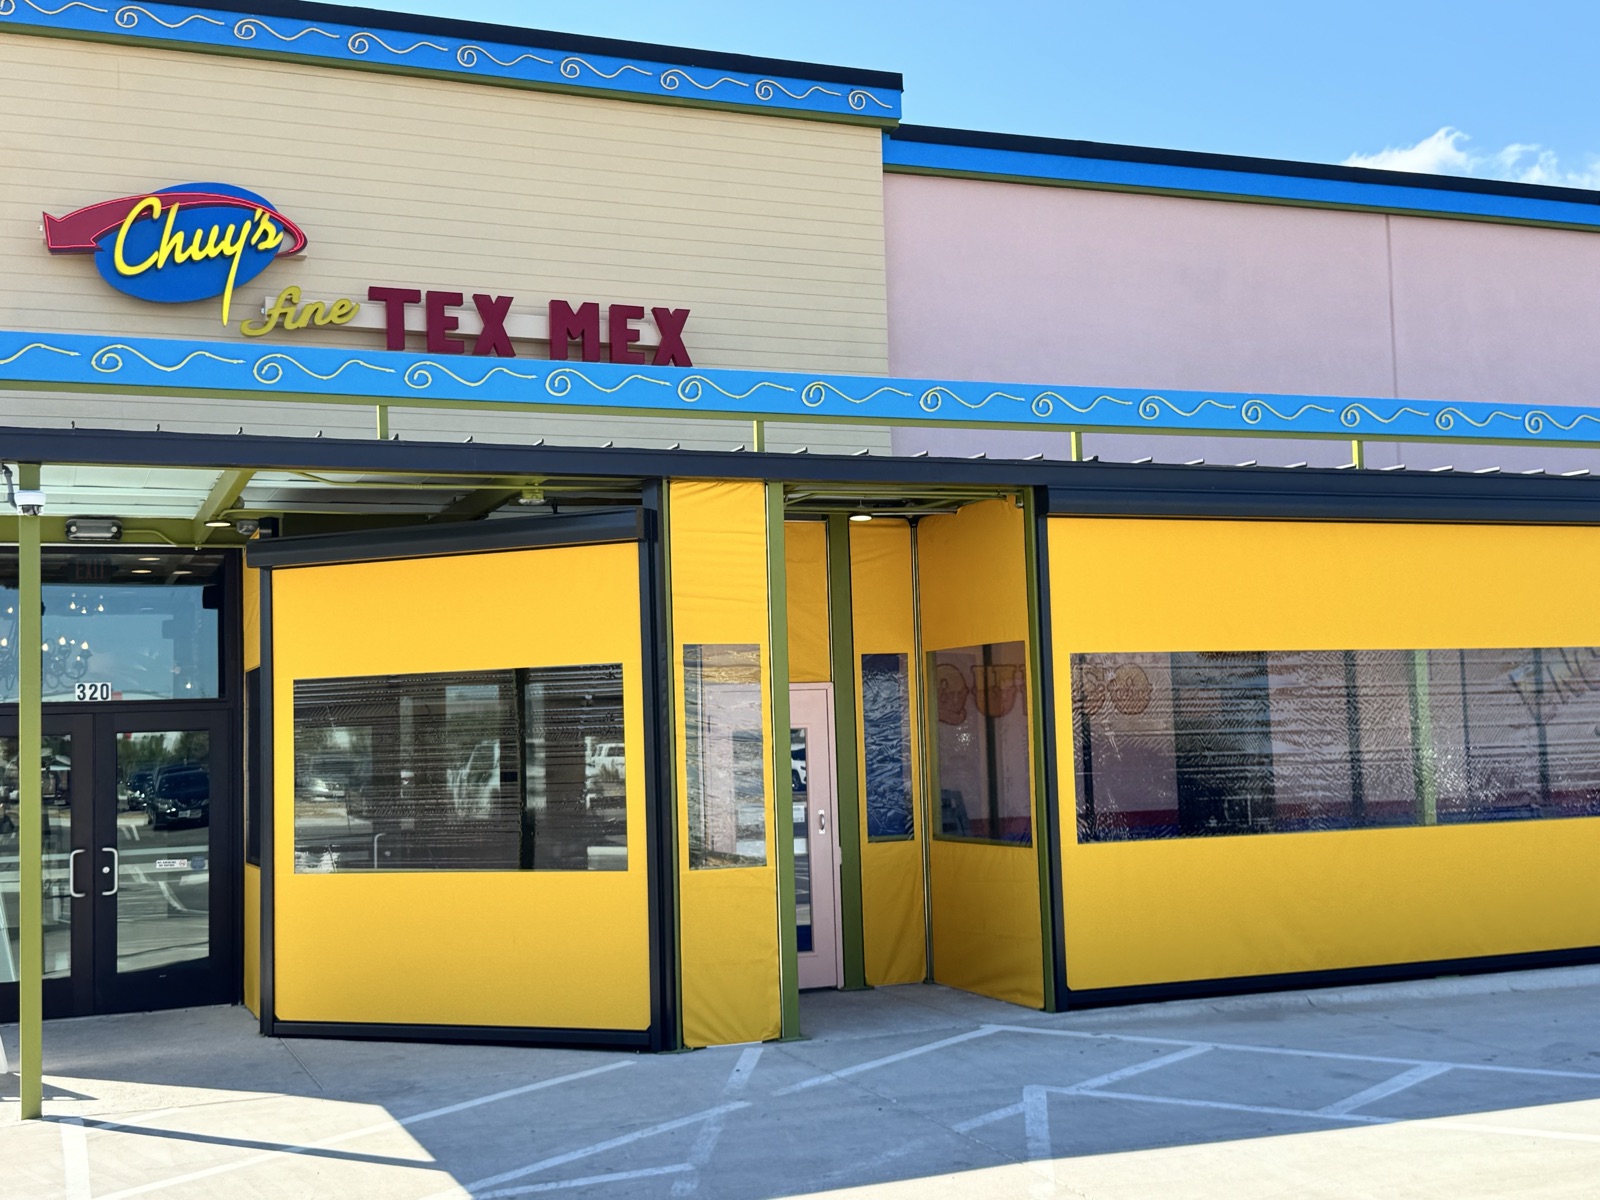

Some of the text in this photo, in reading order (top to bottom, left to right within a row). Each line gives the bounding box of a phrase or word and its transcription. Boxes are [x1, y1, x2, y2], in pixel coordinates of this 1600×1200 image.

[114, 196, 284, 327] Chuy's
[240, 285, 693, 367] fine TEX MEX
[76, 559, 106, 580] EXIT
[77, 683, 110, 701] 320
